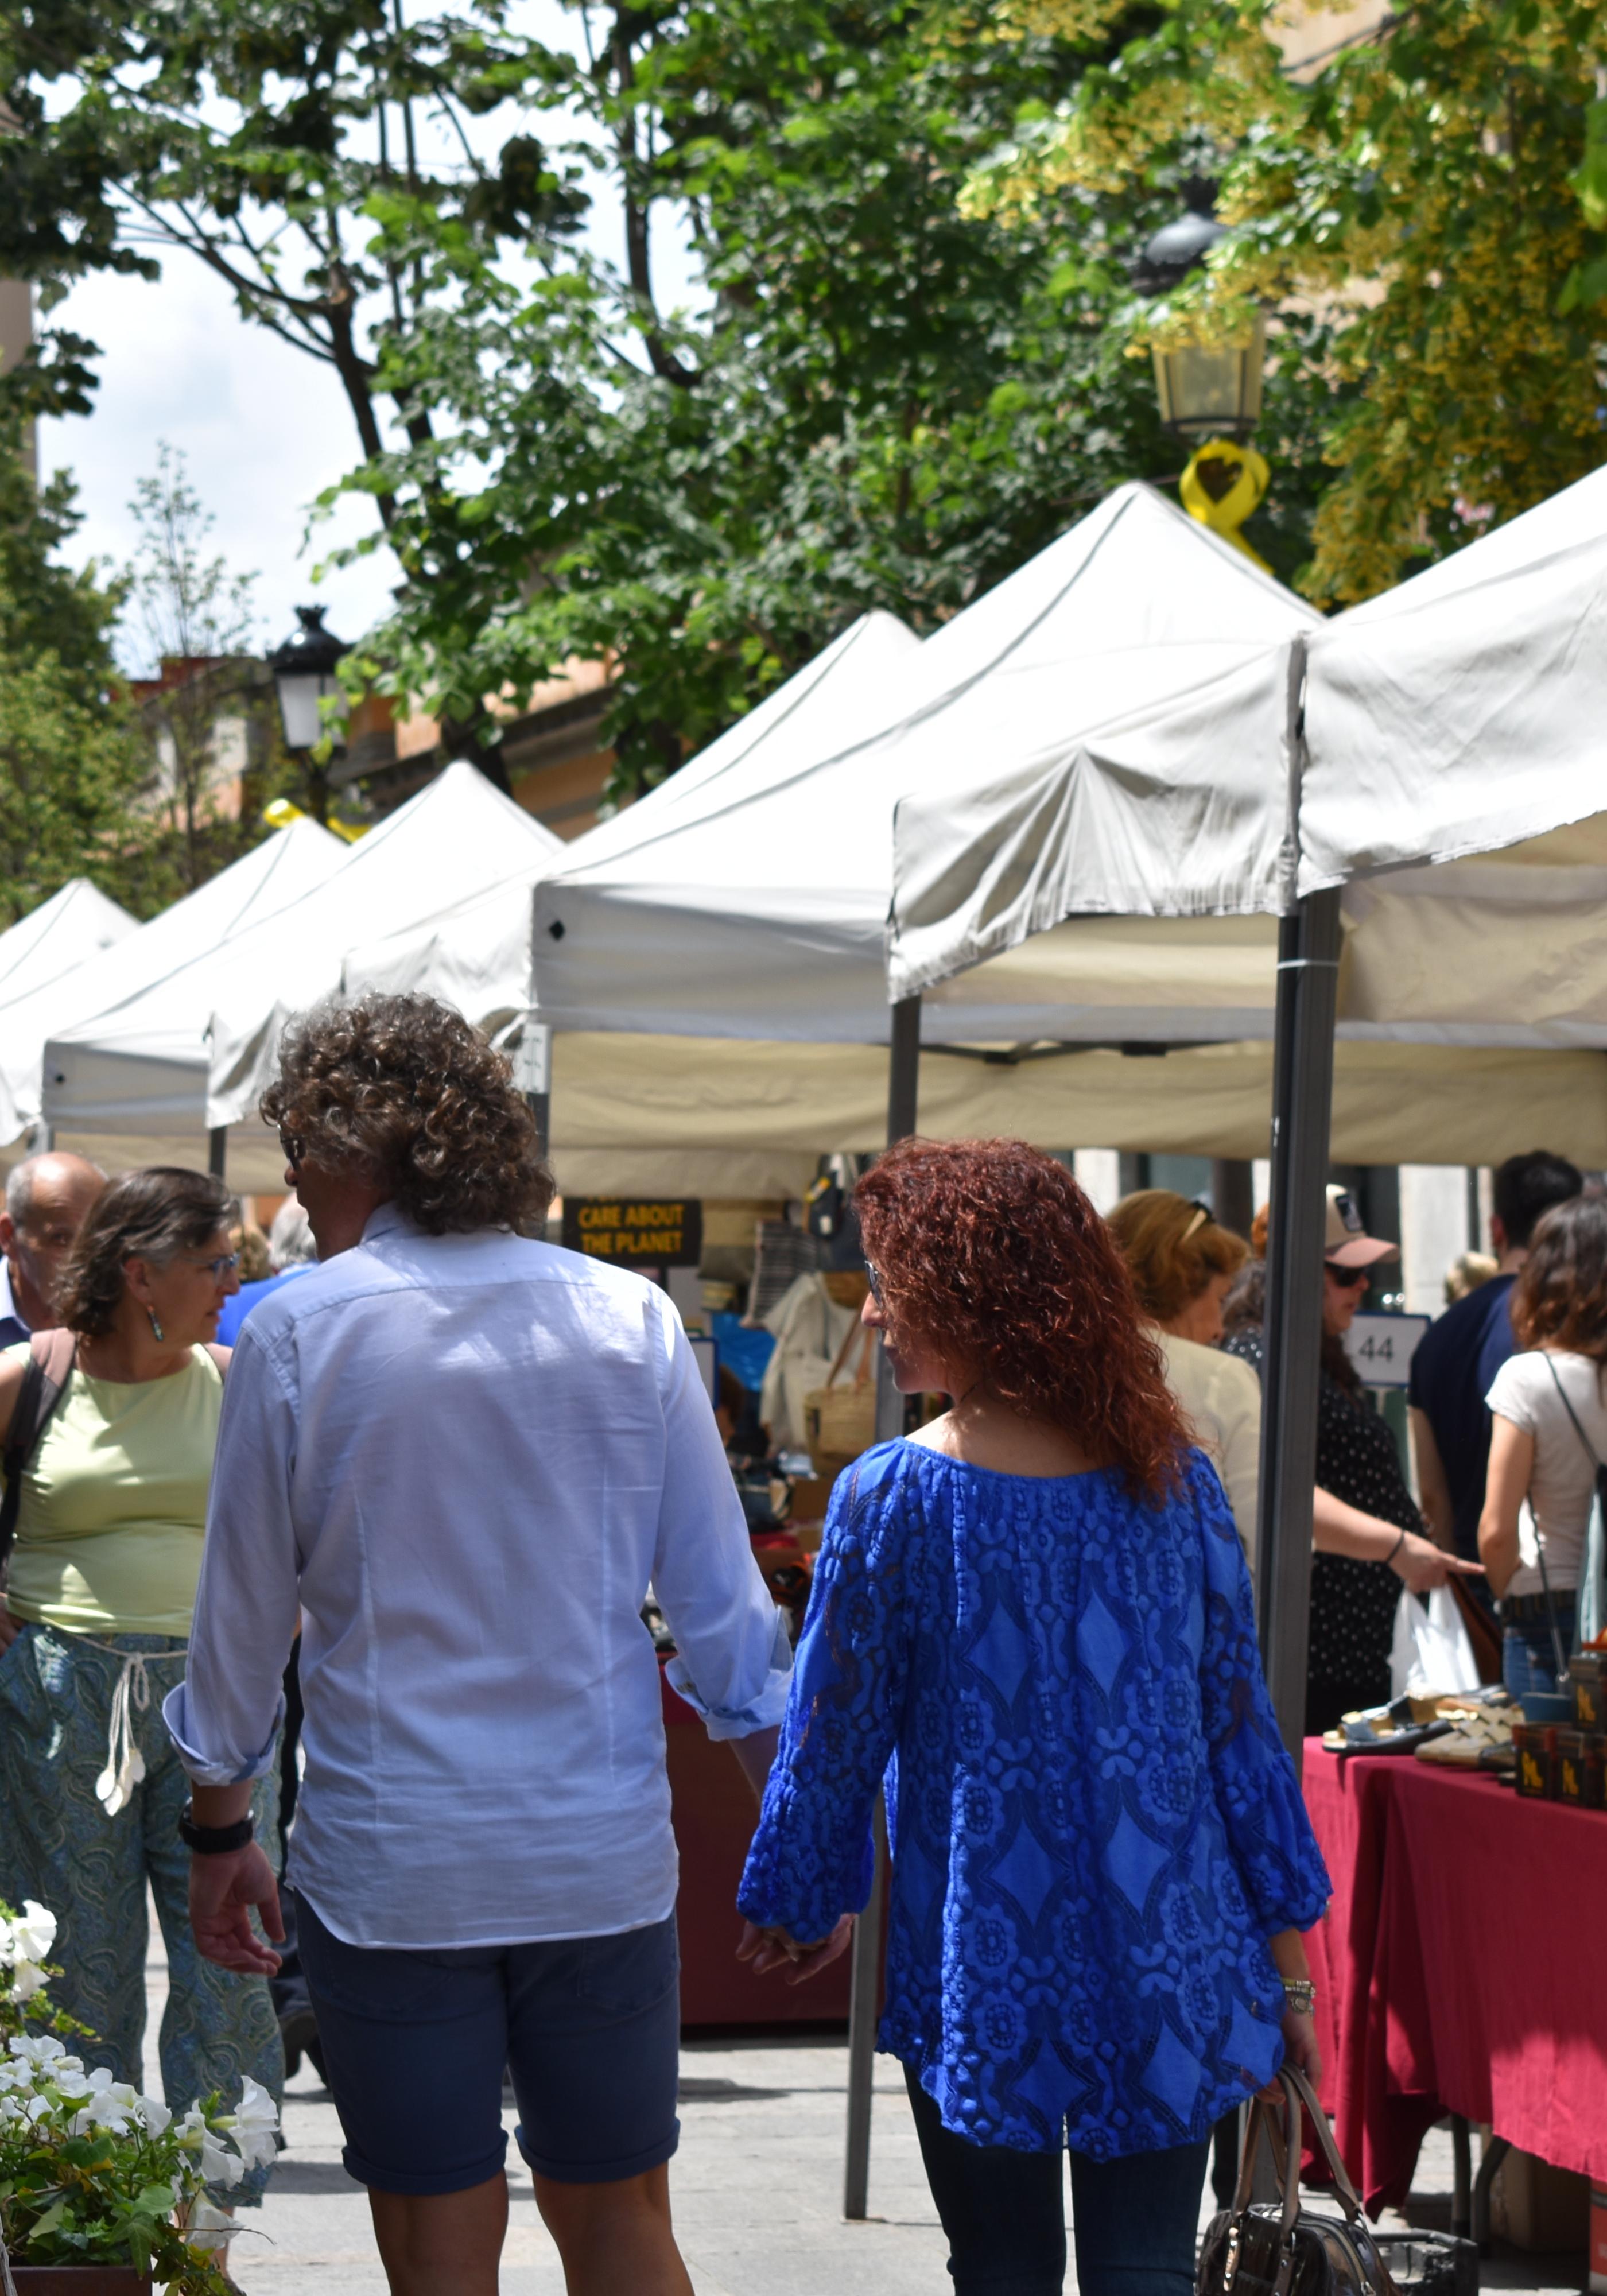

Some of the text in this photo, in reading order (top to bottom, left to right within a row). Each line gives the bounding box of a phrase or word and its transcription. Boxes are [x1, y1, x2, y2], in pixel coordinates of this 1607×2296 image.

[579, 1204, 685, 1228] CARE ABOUT
[581, 1231, 682, 1254] THE PLANET
[1359, 1336, 1393, 1362] 44
